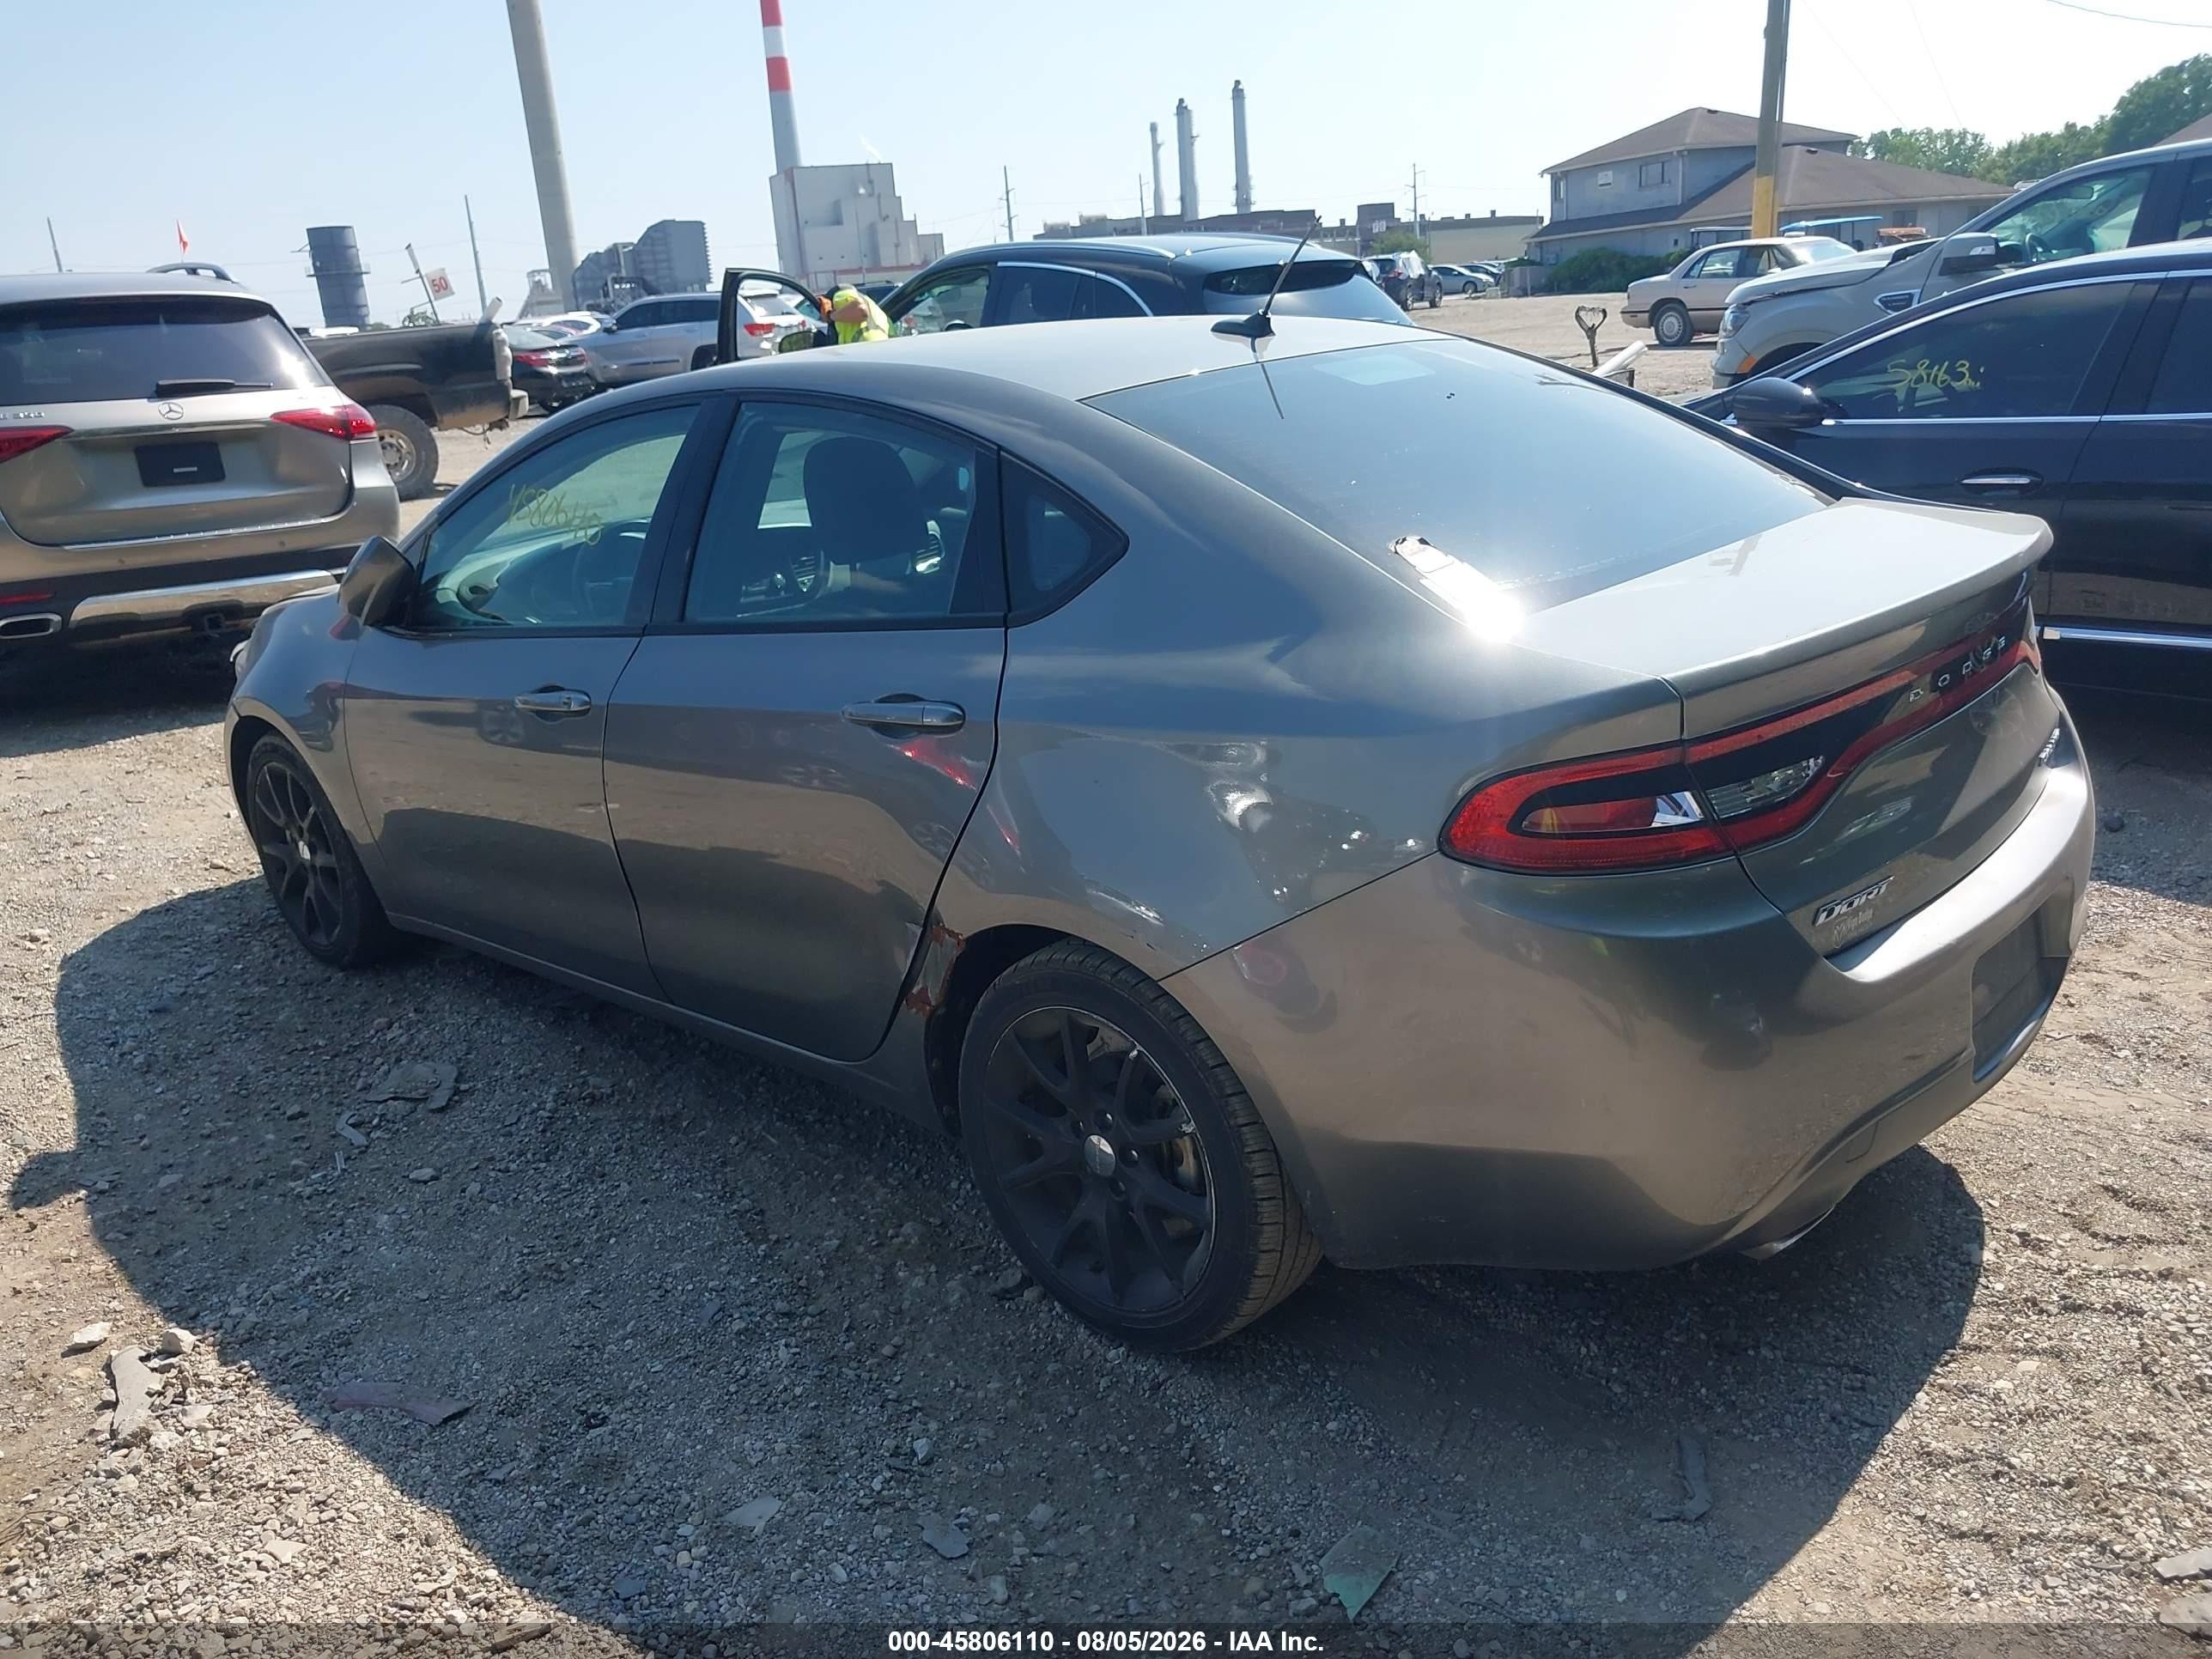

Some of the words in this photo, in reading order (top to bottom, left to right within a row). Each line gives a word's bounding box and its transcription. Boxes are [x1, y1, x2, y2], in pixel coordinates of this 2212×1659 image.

[431, 276, 448, 293] 50
[1909, 635, 2006, 702] DODGE
[1813, 876, 1895, 927] DART
